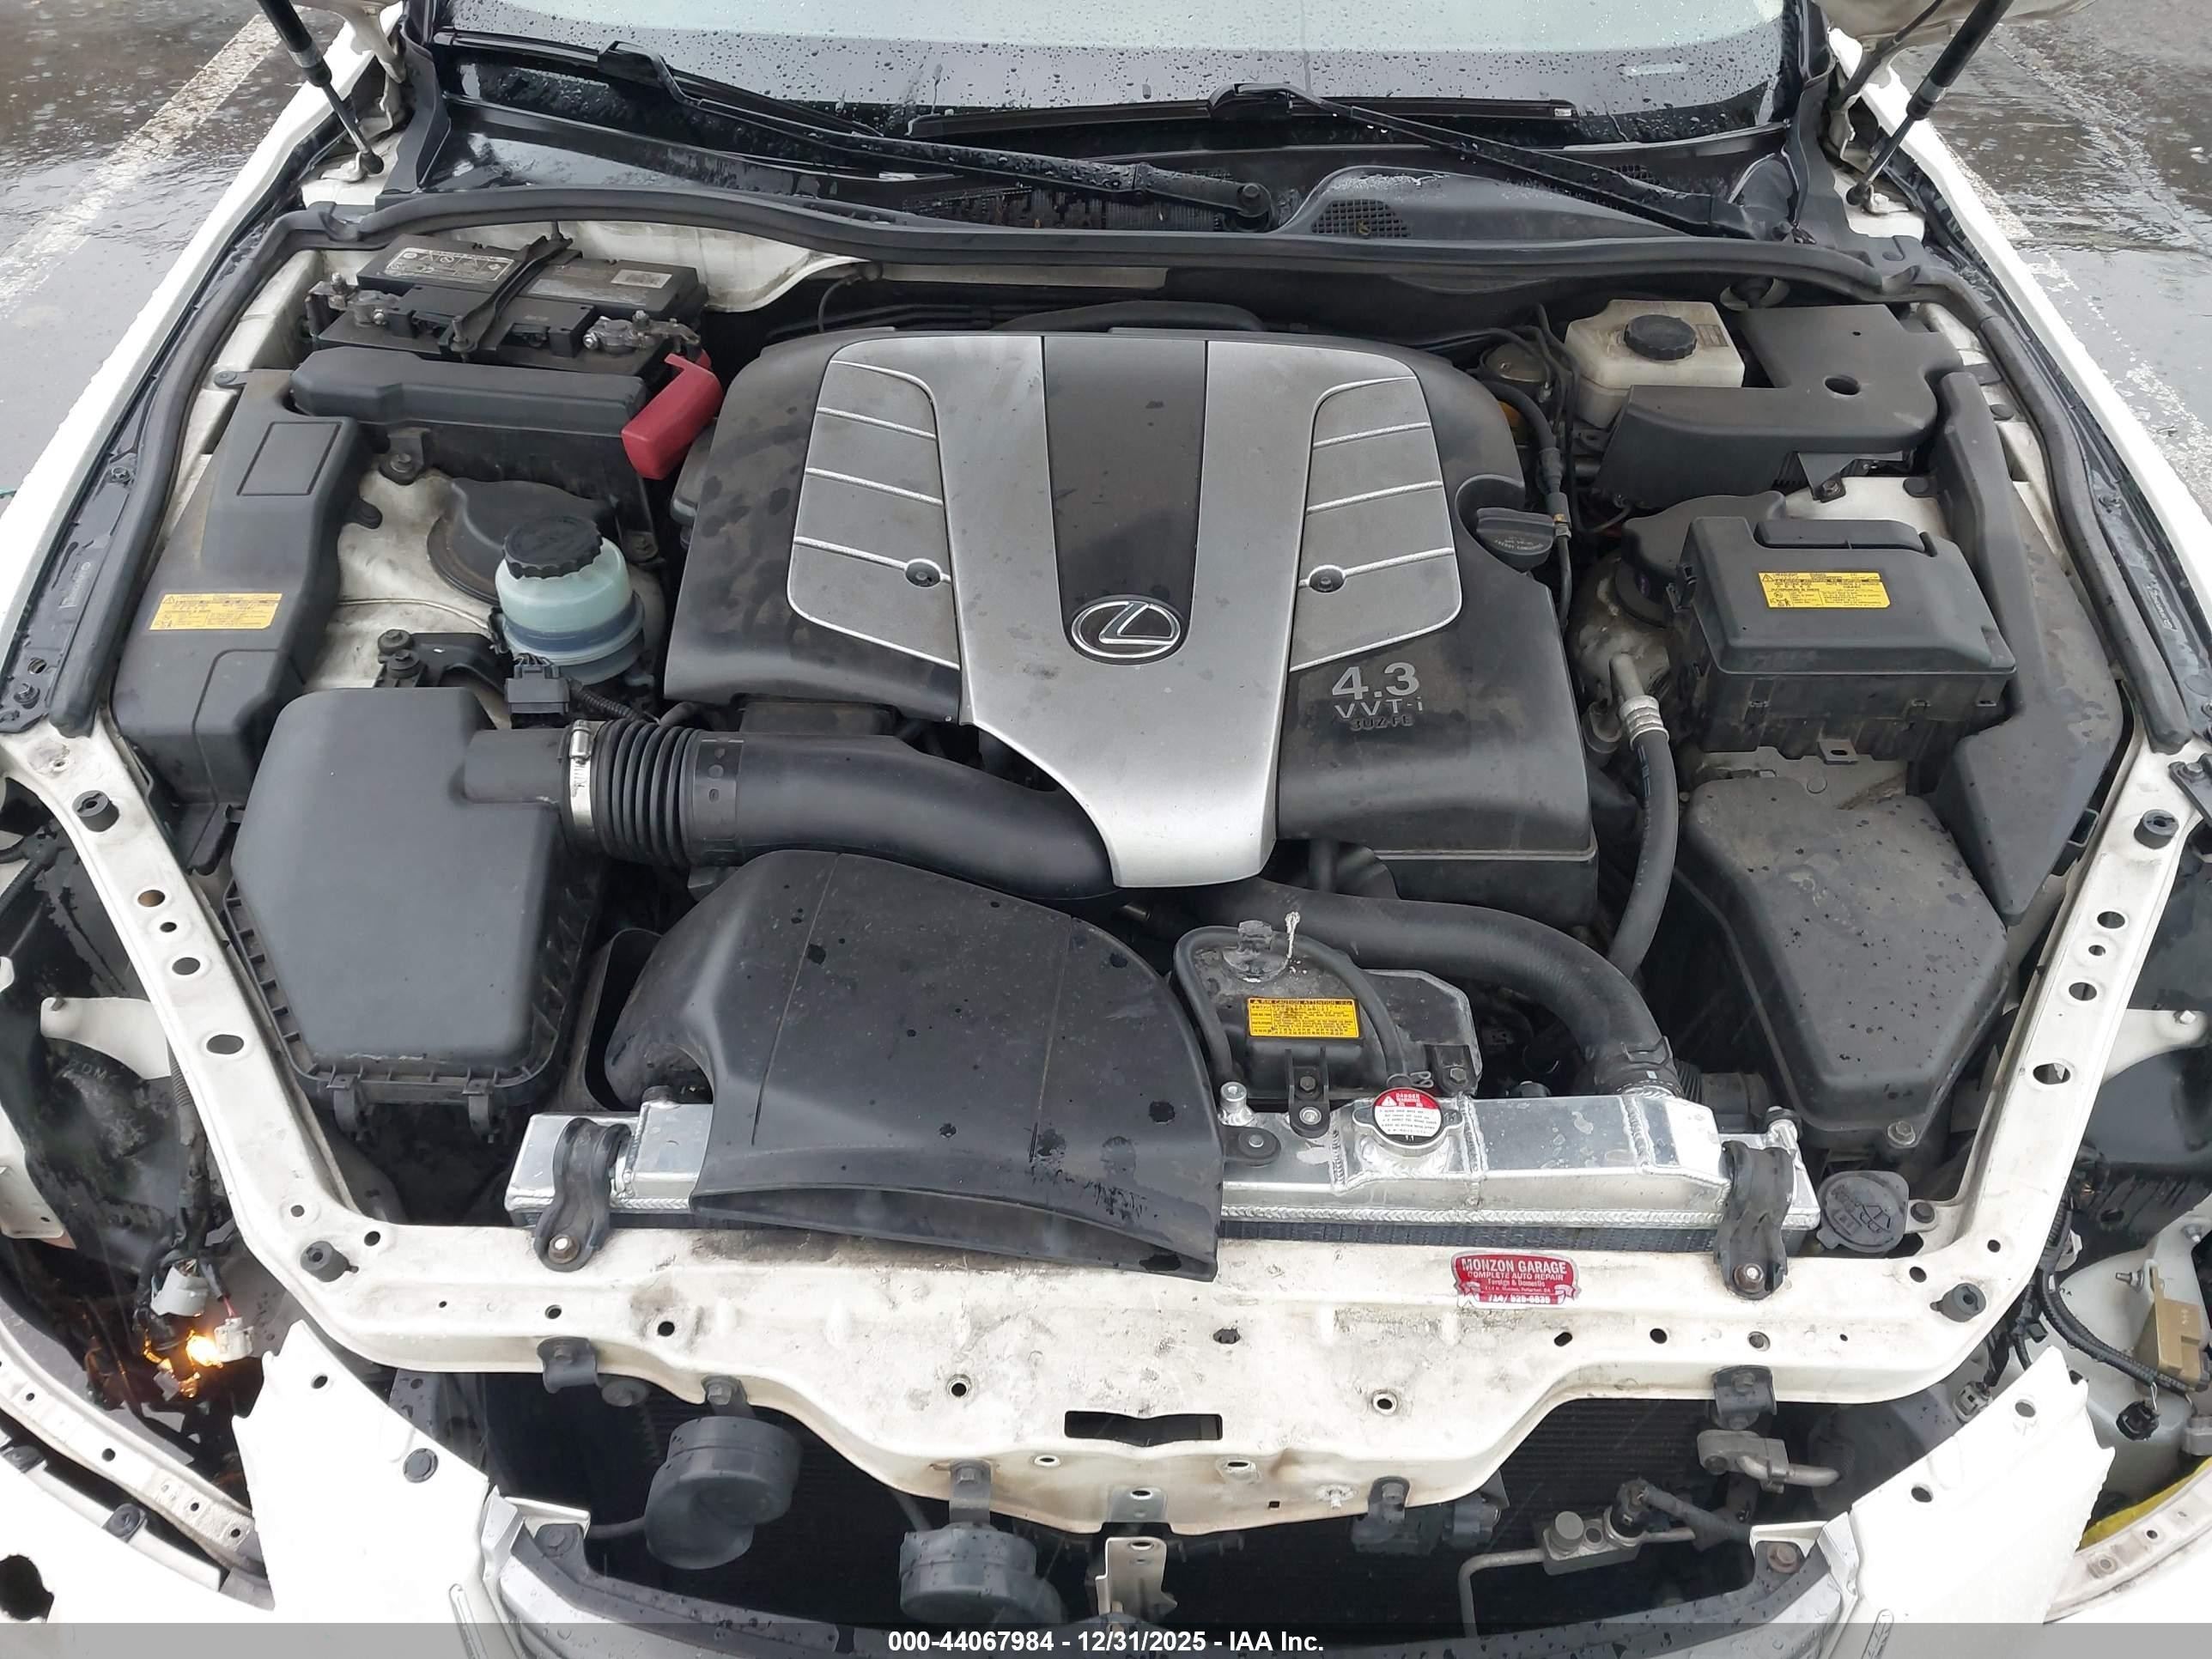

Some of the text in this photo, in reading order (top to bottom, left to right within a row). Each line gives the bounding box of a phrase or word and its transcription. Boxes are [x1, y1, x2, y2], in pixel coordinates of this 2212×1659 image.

[1332, 662, 1420, 701] 4.3
[1334, 696, 1423, 719] VVT-i
[1462, 1258, 1568, 1275] MONZON GARAGE
[1468, 1271, 1510, 1279] COMPLETE
[1512, 1272, 1533, 1280] AUTO
